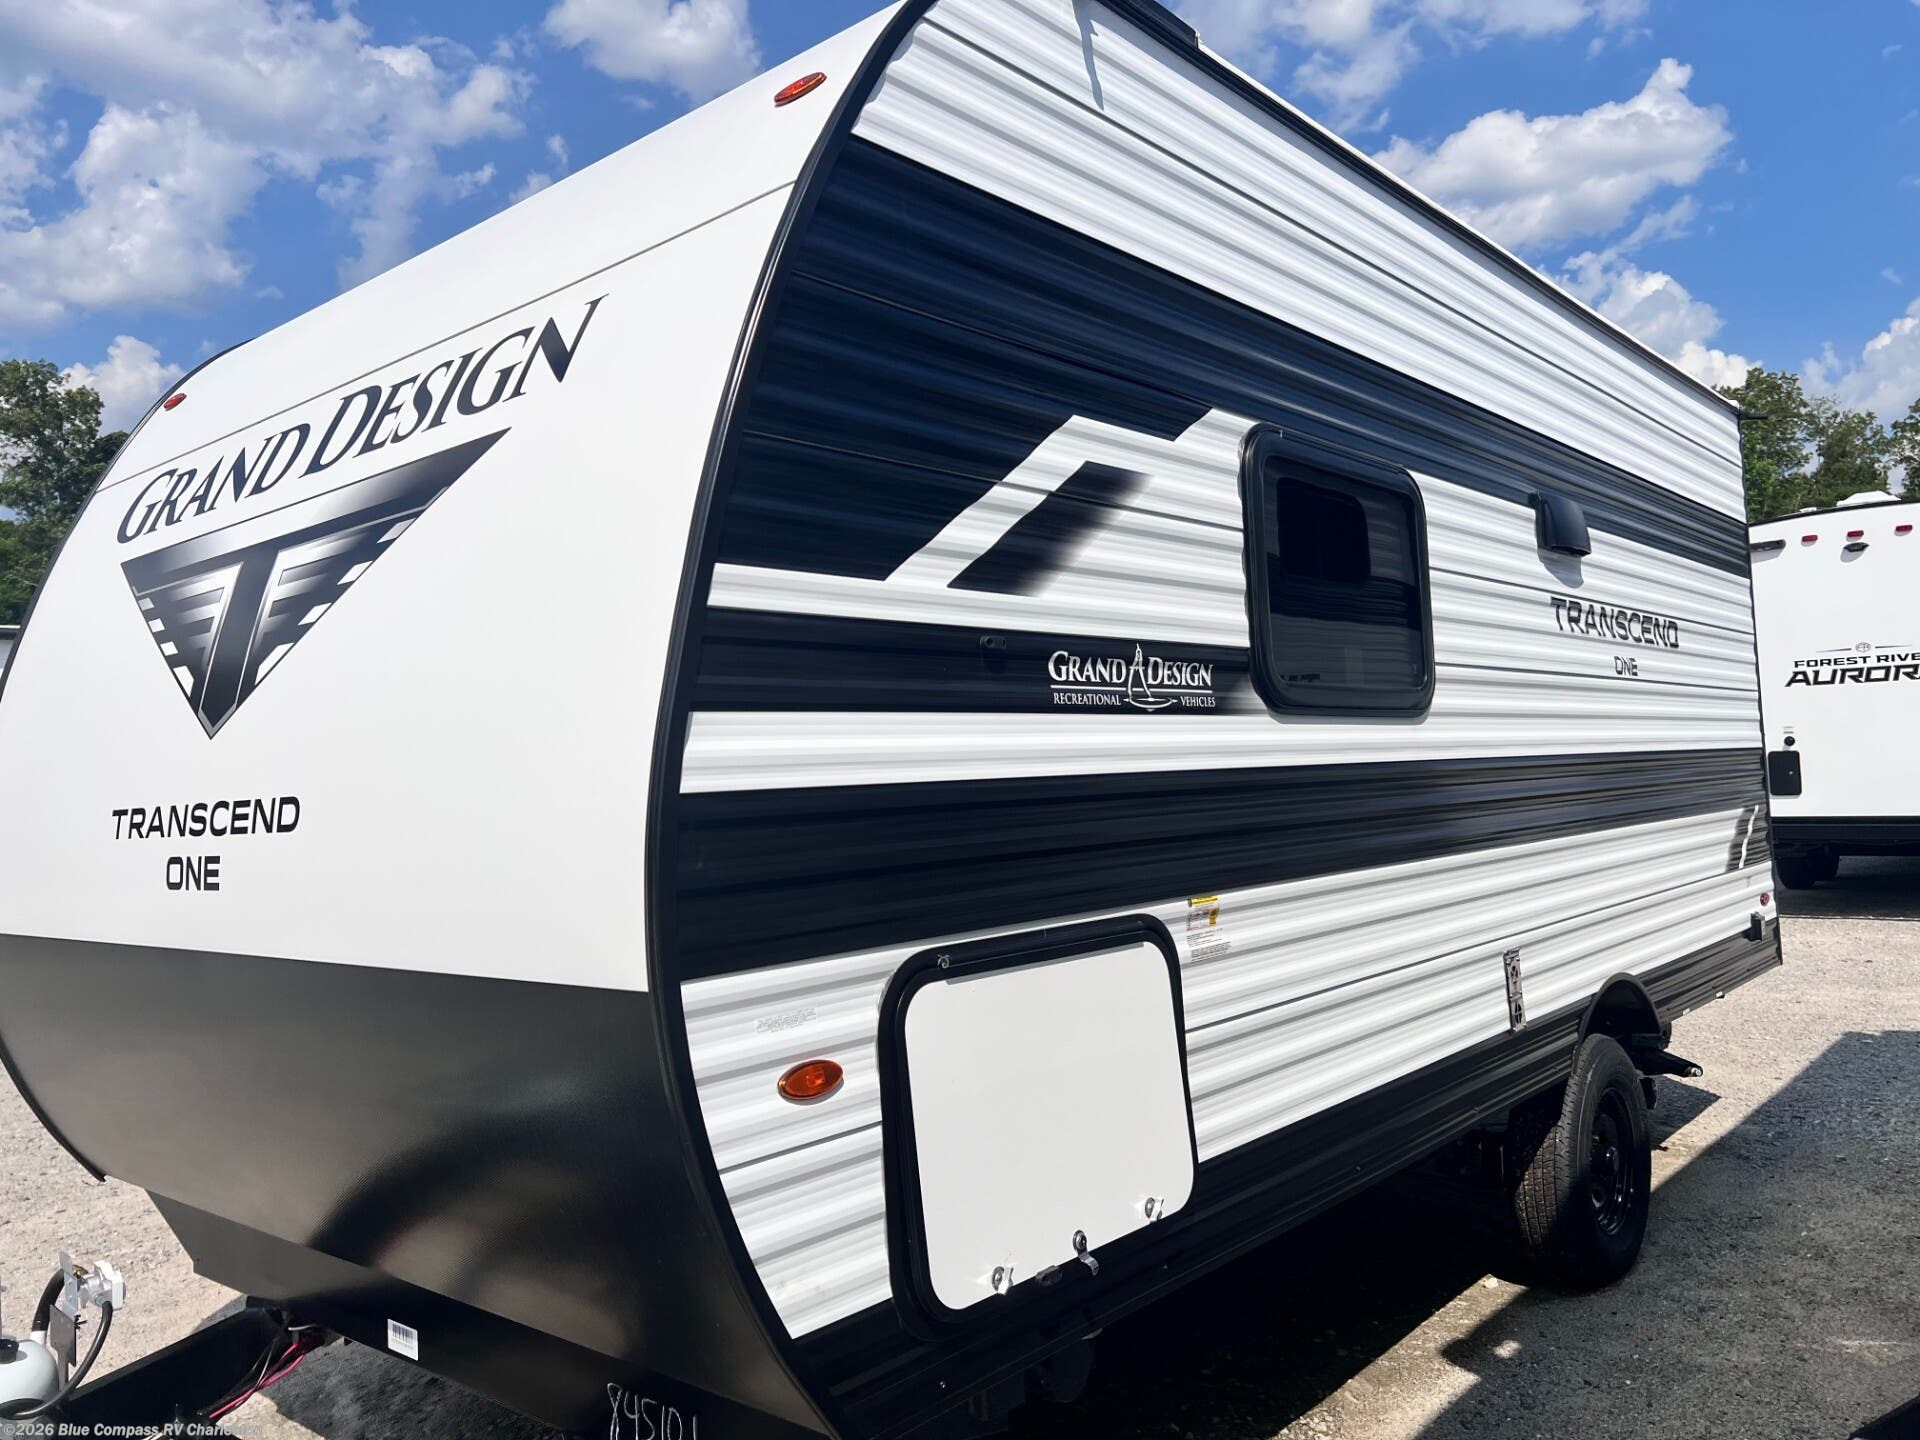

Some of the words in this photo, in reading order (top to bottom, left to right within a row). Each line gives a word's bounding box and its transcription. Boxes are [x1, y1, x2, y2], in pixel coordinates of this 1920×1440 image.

[1550, 595, 1680, 649] TRANSCEND
[1613, 655, 1638, 677] ONE
[1793, 655, 1871, 669] FOREST
[1053, 692, 1122, 706] RECREATIONAL
[1180, 695, 1216, 708] VEHICLES
[112, 796, 301, 839] TRANSCEND
[166, 855, 221, 891] ONE
